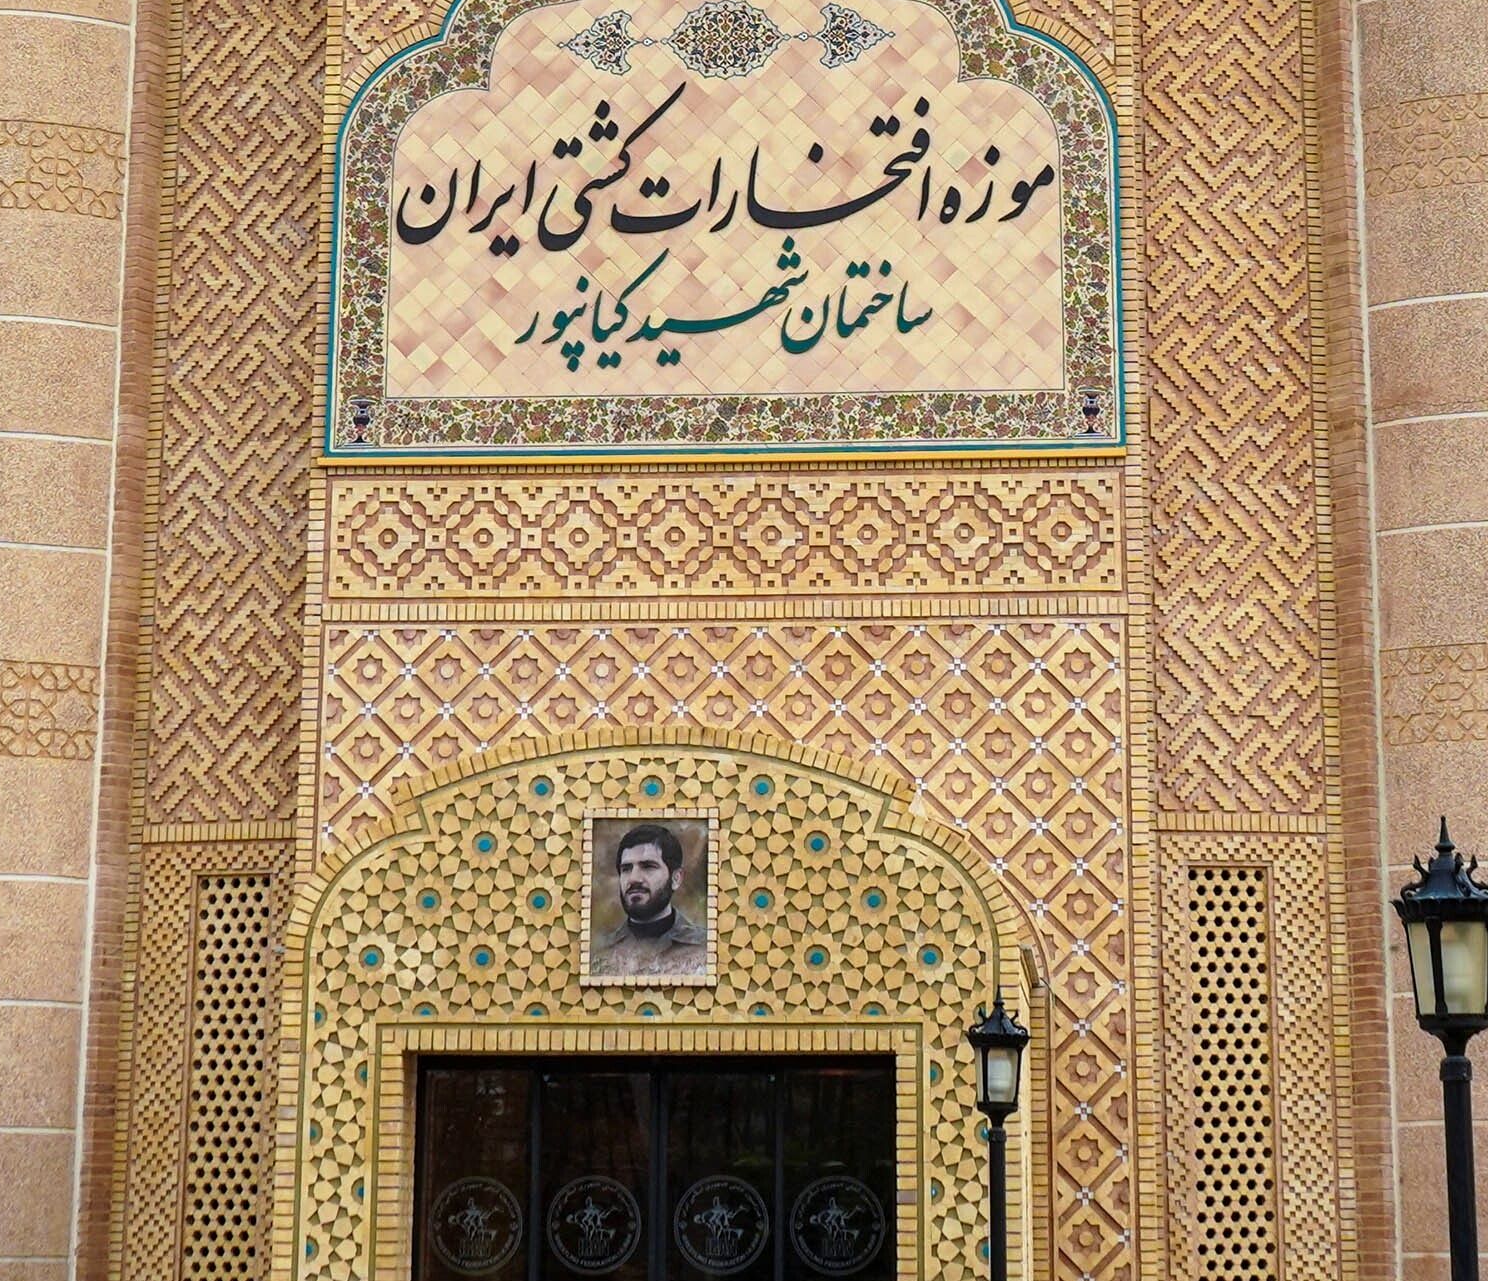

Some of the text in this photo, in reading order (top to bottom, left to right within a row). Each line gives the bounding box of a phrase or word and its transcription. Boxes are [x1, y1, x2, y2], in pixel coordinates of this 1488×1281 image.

[396, 82, 1056, 258] موزه افتخارات کشتی ایران
[624, 235, 810, 368] شهید
[780, 260, 934, 356] ساختمان
